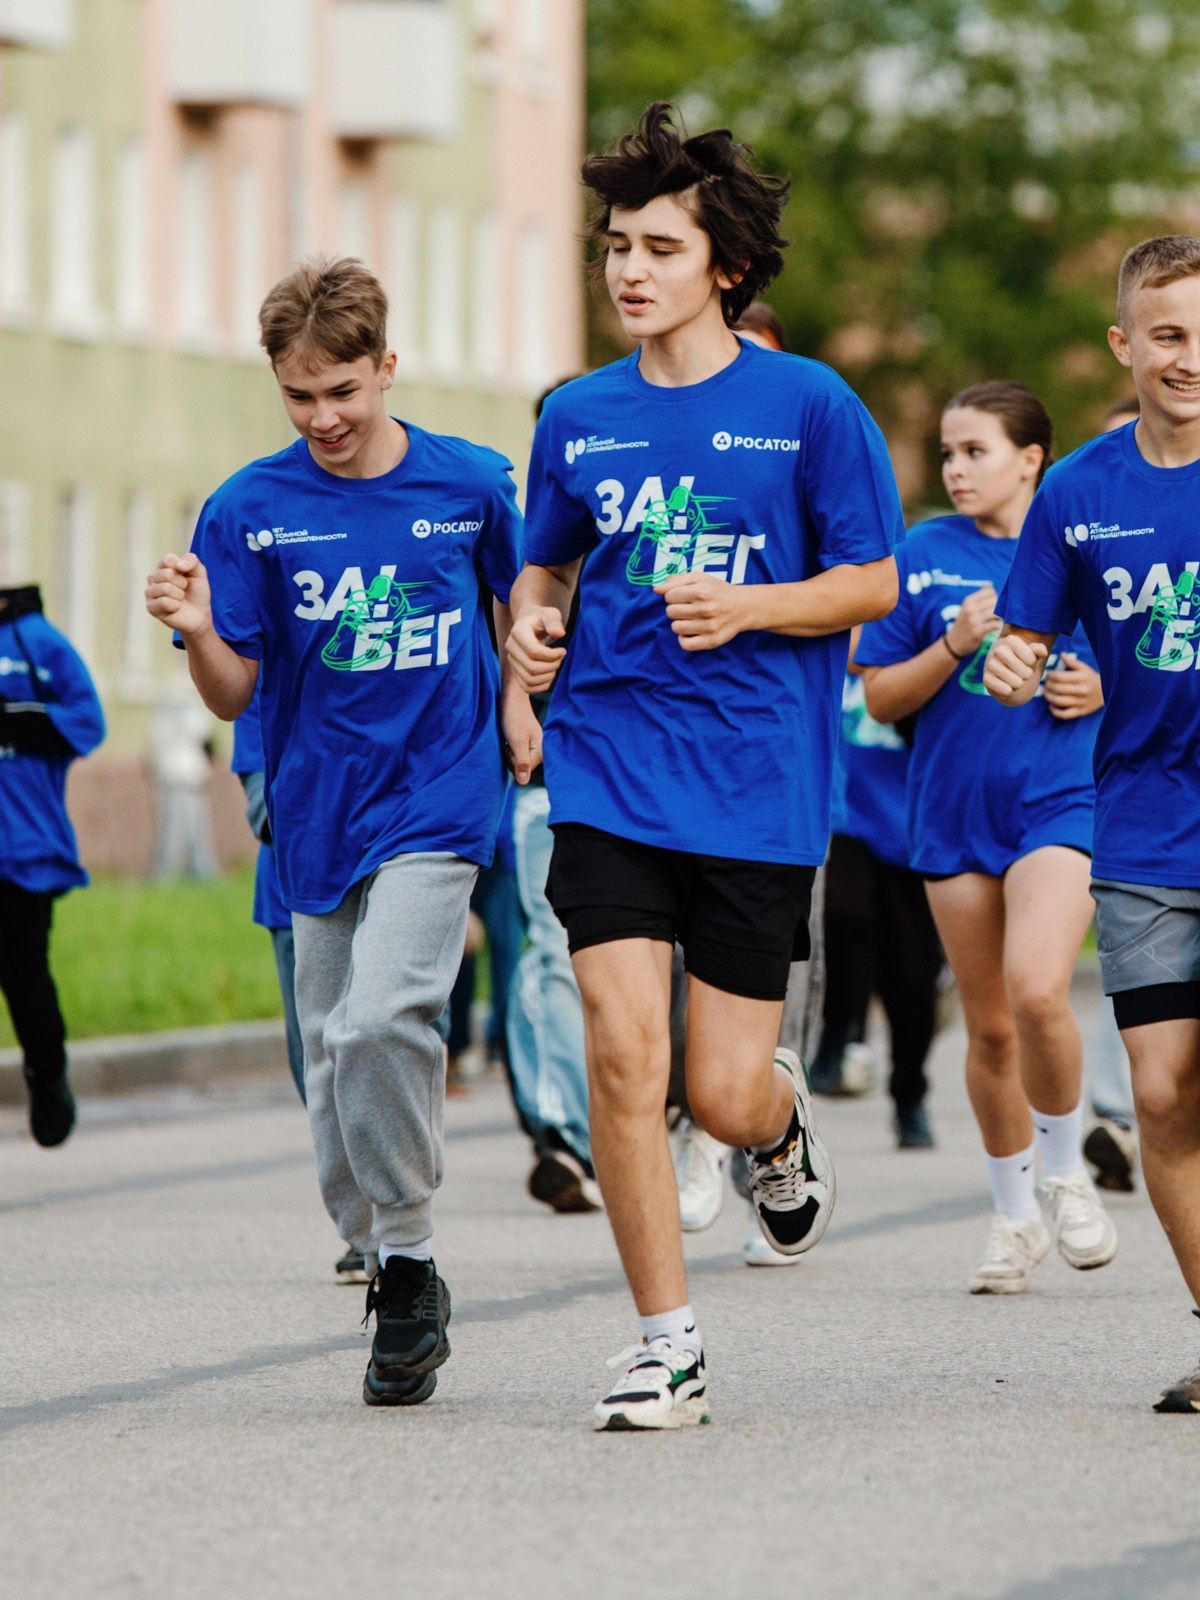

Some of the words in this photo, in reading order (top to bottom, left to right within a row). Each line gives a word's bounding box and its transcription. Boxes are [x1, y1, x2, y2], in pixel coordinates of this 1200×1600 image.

[733, 436, 801, 451] РОСАТОМ
[433, 519, 485, 534] РОСАТО
[594, 475, 696, 536] ЗА!
[274, 529, 309, 540] ТОМНОЙ
[275, 533, 348, 546] РОМЫШЛЕННОСТИ
[651, 533, 767, 587] БЕГ
[292, 564, 398, 621] ЗА!
[1102, 561, 1200, 621] ЗА!
[350, 607, 462, 672] БЕГ
